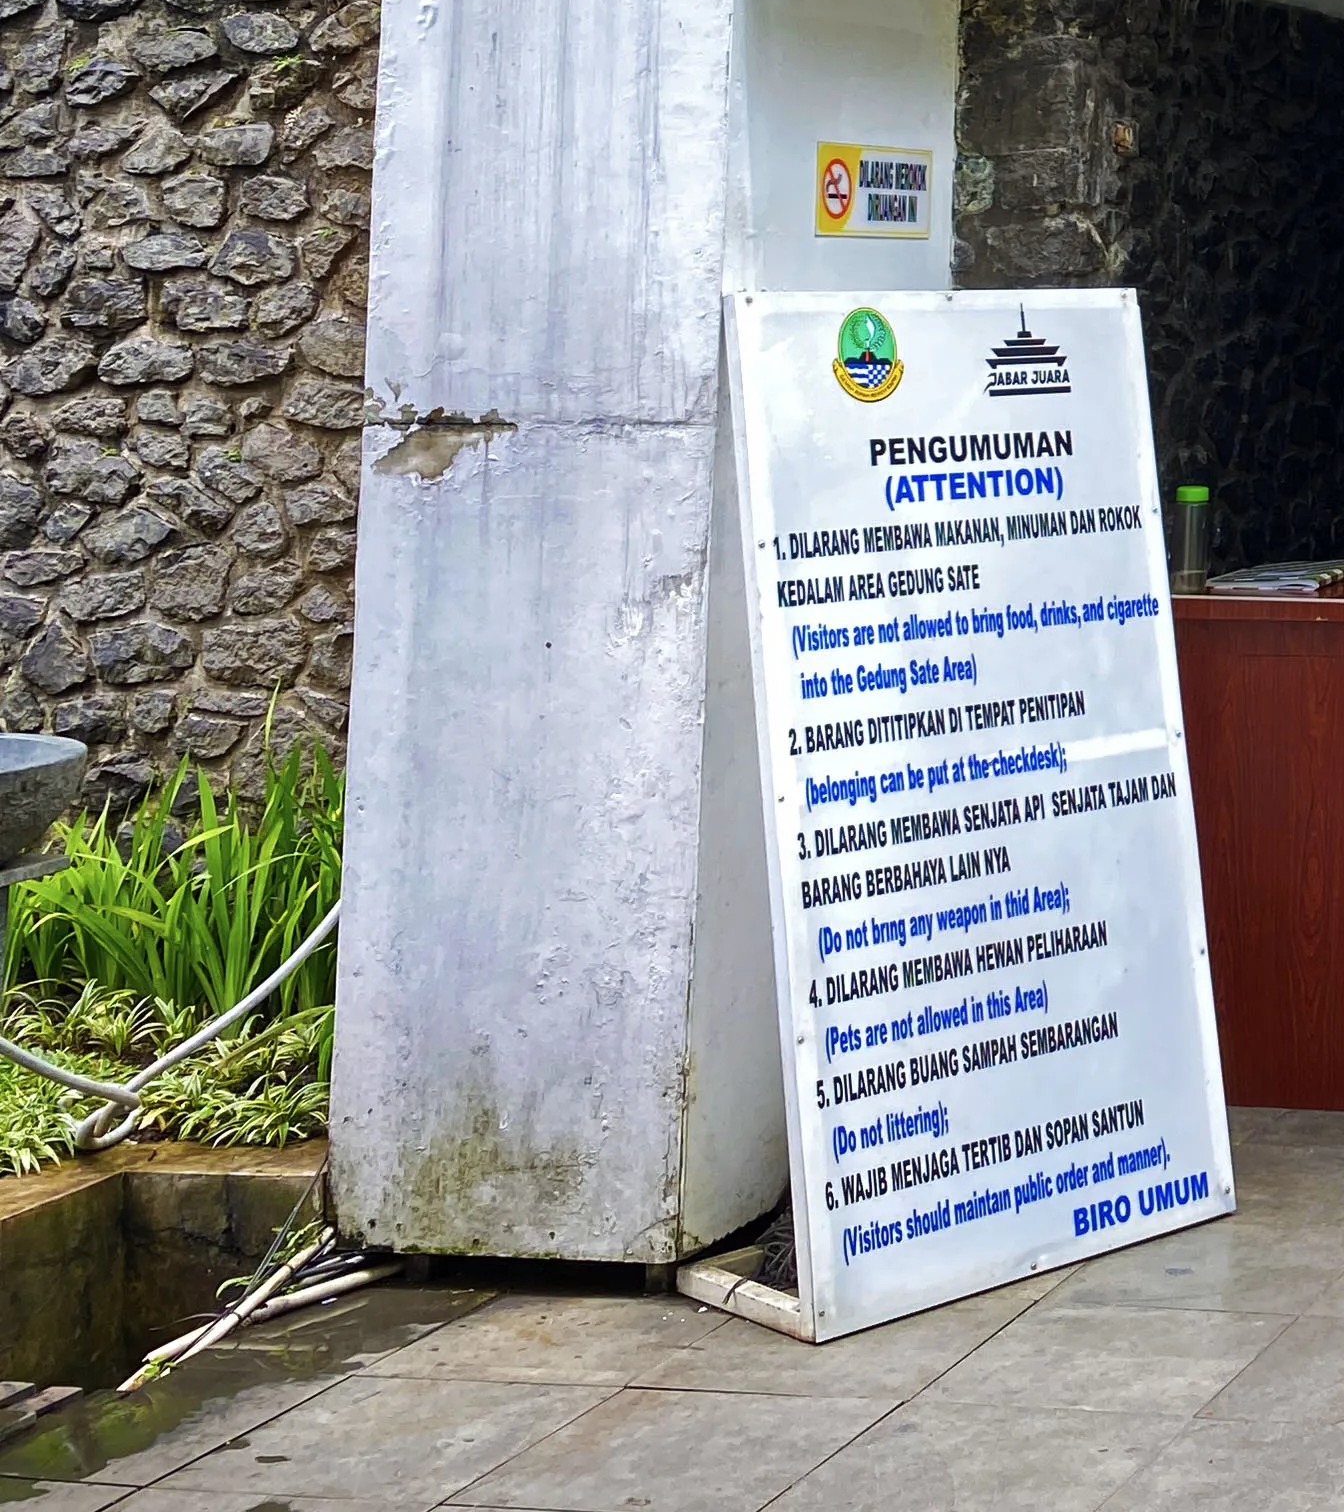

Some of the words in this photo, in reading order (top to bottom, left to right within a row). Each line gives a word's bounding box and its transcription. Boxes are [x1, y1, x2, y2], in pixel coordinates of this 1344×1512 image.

[985, 371, 1028, 389] JABAR
[1031, 369, 1070, 385] JUARA
[869, 430, 1073, 466] PENGUMUMAN
[885, 466, 1063, 511] (ATTENTION)
[772, 536, 786, 560] 1.
[788, 528, 860, 559] DILARANG
[862, 522, 932, 553] MEMBAWA
[934, 516, 1004, 547] MAKANAN,
[1006, 511, 1067, 540] MINUMAN
[1069, 508, 1096, 535] DAN
[1097, 505, 1142, 532] ROKOK
[777, 576, 845, 607] KEDALAM
[848, 572, 885, 601] AREA
[887, 567, 944, 597] GEDUNG
[947, 564, 980, 592] SATE
[800, 672, 828, 699] into
[830, 667, 853, 695] the
[856, 663, 907, 694] Gedung
[909, 658, 939, 686] Sate
[943, 653, 977, 685] Area)
[788, 728, 802, 756] 2.
[804, 719, 864, 753] BARANG
[867, 708, 945, 744] DITITIPKAN
[948, 706, 963, 733] DI
[964, 699, 1015, 731] TEMPAT
[1018, 690, 1085, 724] PENITIPAN
[797, 832, 811, 860] 3.
[814, 820, 887, 857] DILARANG
[890, 807, 961, 845] MEMBAWA
[963, 798, 1021, 832] SENJATA
[1024, 793, 1045, 822] API
[1051, 783, 1107, 817] SENJATA
[1107, 776, 1149, 807] TAJAM
[1150, 772, 1176, 800] DAN
[818, 926, 842, 963] (Do
[845, 920, 868, 950] not
[871, 917, 906, 947] bring
[909, 913, 933, 941] any
[936, 902, 987, 933] weapon
[989, 894, 1002, 921] in
[1004, 887, 1030, 918] thid
[1033, 881, 1070, 914] Area);
[816, 1079, 830, 1109] 5.
[833, 1060, 906, 1105] DILARANG
[909, 1048, 959, 1086] BUANG
[961, 1034, 1017, 1073] SAMPAH
[1020, 1011, 1118, 1059] SEMBARANGAN
[832, 1125, 856, 1164] (Do
[860, 1117, 884, 1149] not
[885, 1100, 949, 1142] littering);
[843, 1220, 903, 1266] (Visitors
[906, 1198, 951, 1239] should
[953, 1188, 1011, 1225] maintain
[1013, 1171, 1053, 1214] public
[1055, 1162, 1088, 1194] order
[1091, 1151, 1115, 1184] and
[1117, 1137, 1170, 1176] manner).
[1073, 1195, 1131, 1237] BIRO
[1138, 1171, 1208, 1216] UMUM
